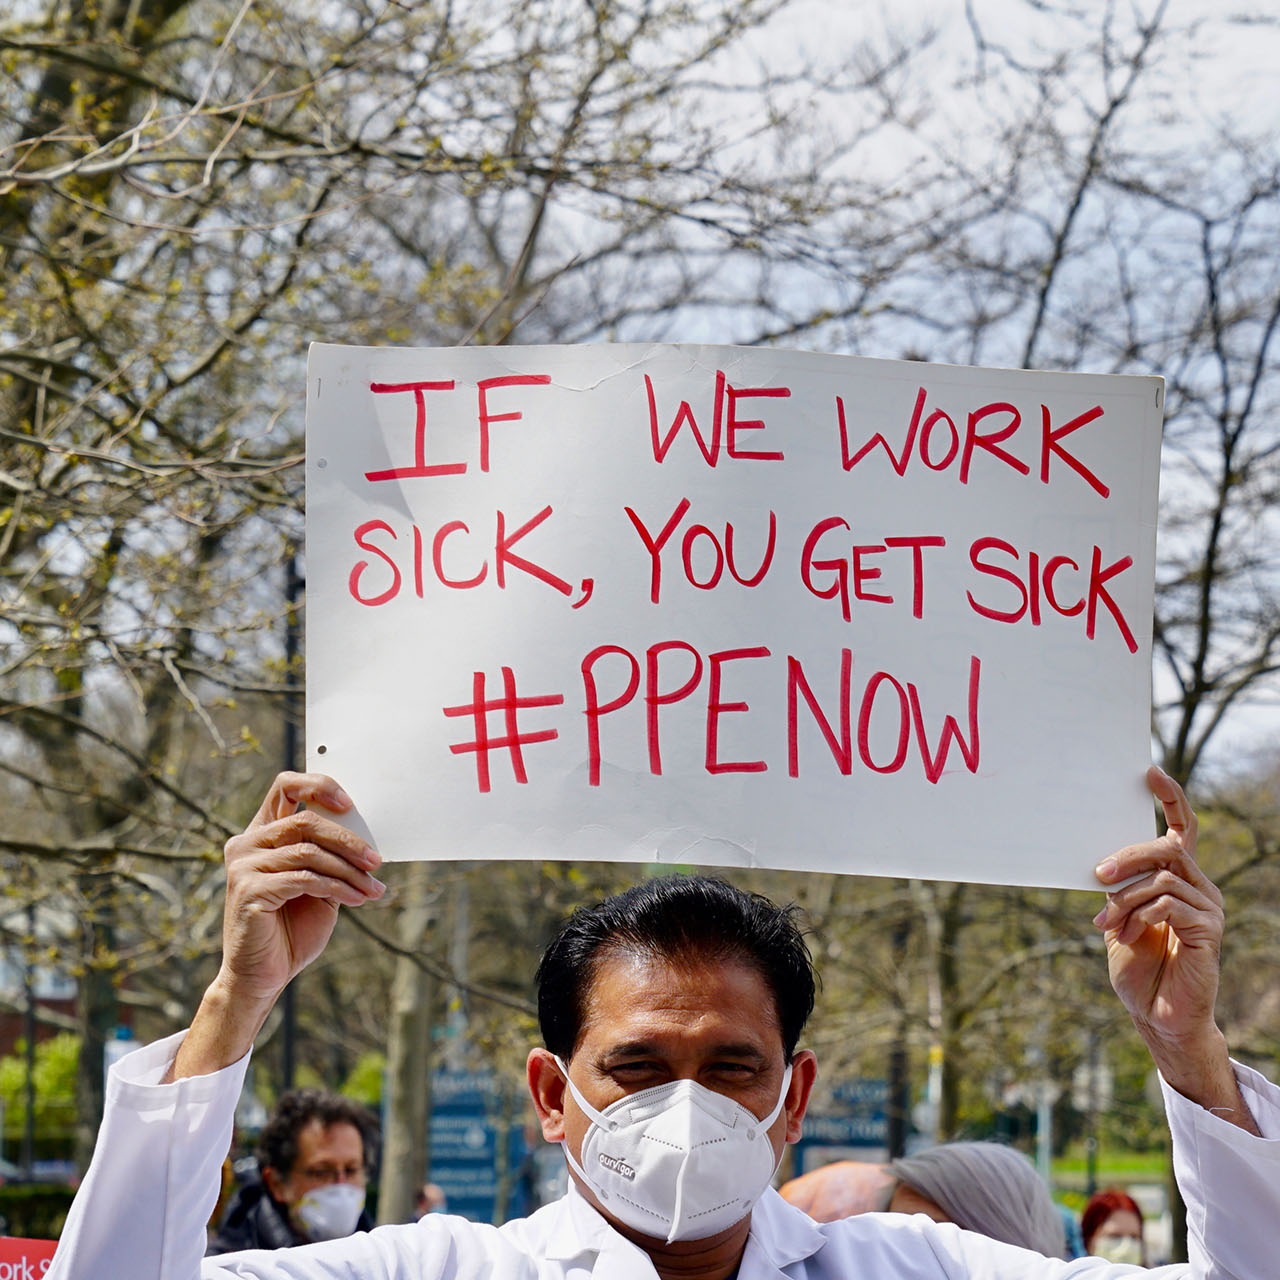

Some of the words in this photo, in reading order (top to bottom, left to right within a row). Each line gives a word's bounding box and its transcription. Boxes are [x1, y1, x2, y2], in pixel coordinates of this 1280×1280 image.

[365, 375, 552, 482] IF
[644, 369, 790, 467] WE
[836, 387, 1110, 499] WORK
[349, 504, 594, 609] SICK,
[625, 497, 776, 605] YOU
[800, 515, 946, 622] GET
[966, 536, 1138, 654] SICK
[443, 640, 981, 792] #PPENOW
